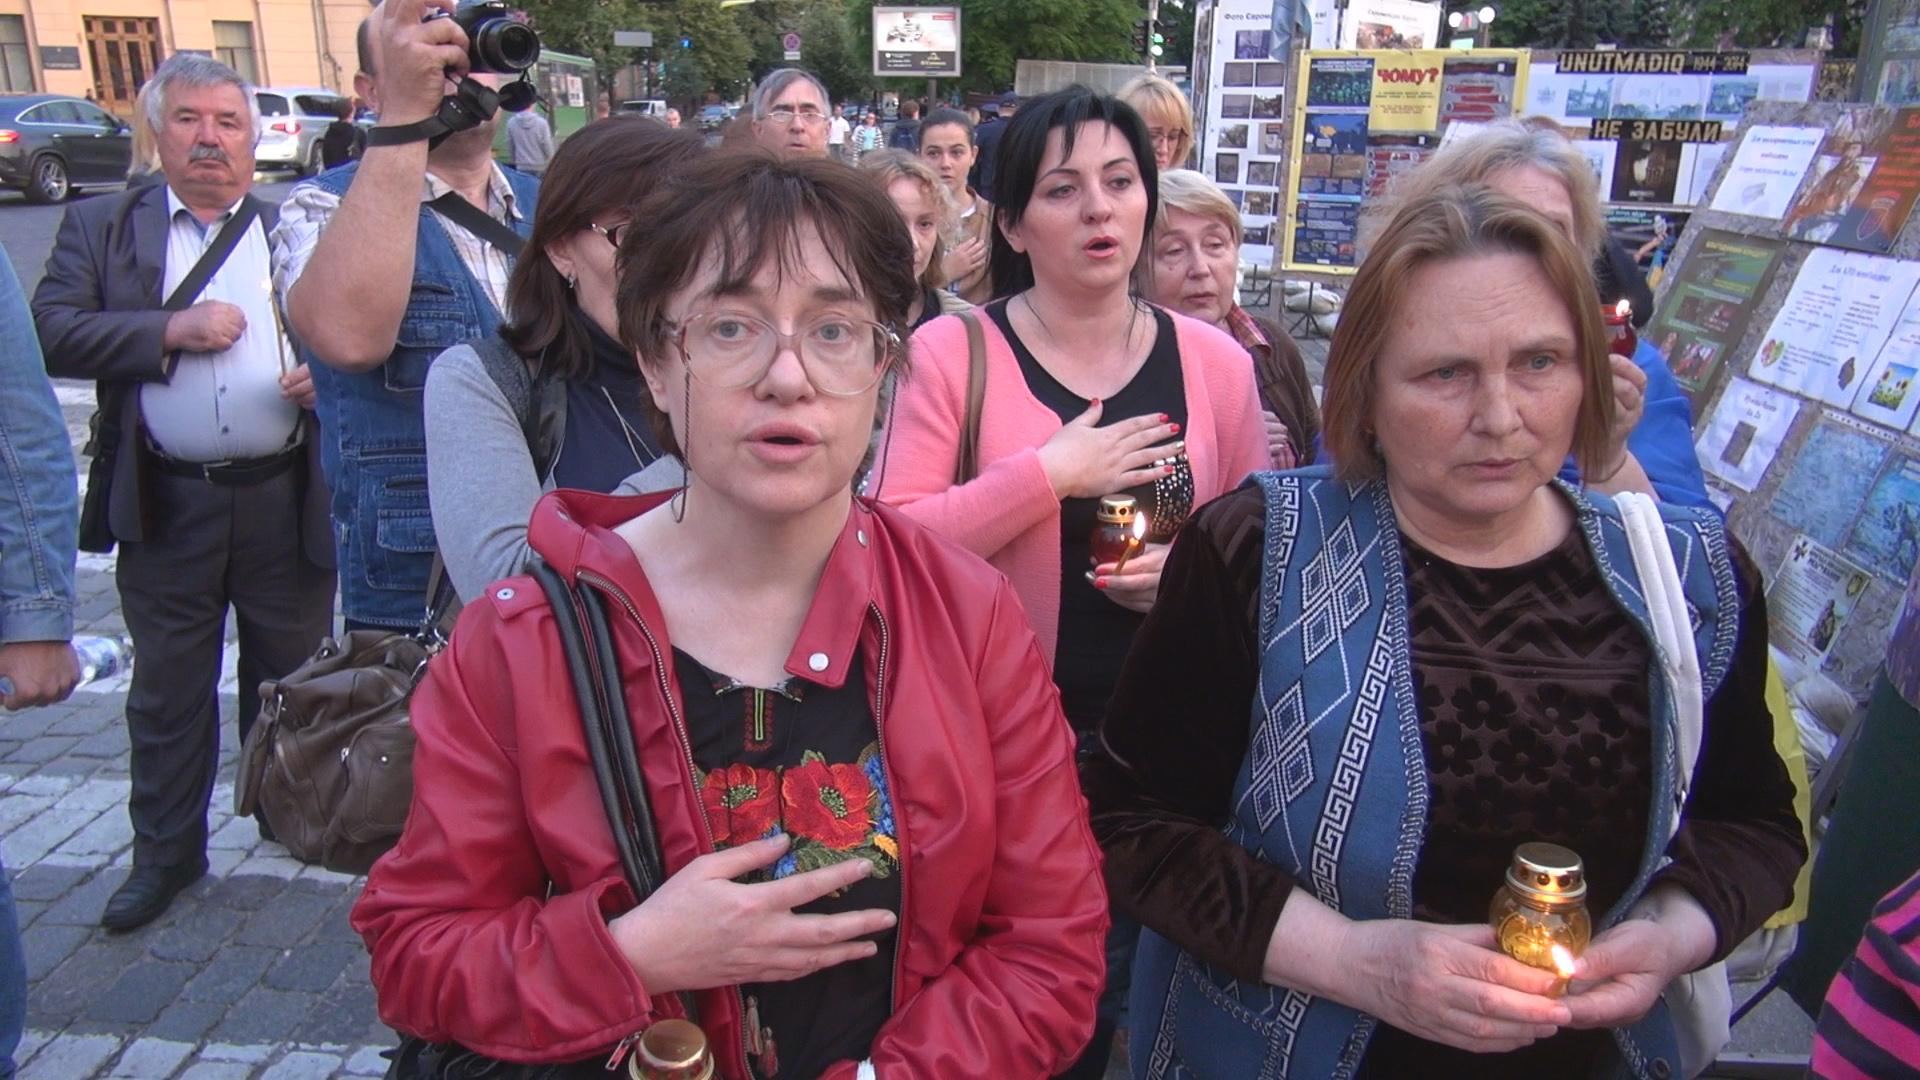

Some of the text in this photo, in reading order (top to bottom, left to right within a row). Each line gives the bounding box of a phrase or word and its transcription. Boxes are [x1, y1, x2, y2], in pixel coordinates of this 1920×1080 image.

[1377, 67, 1439, 86] ЧОМУ?
[1594, 120, 1719, 142] НЕ ЗАБУЛИ
